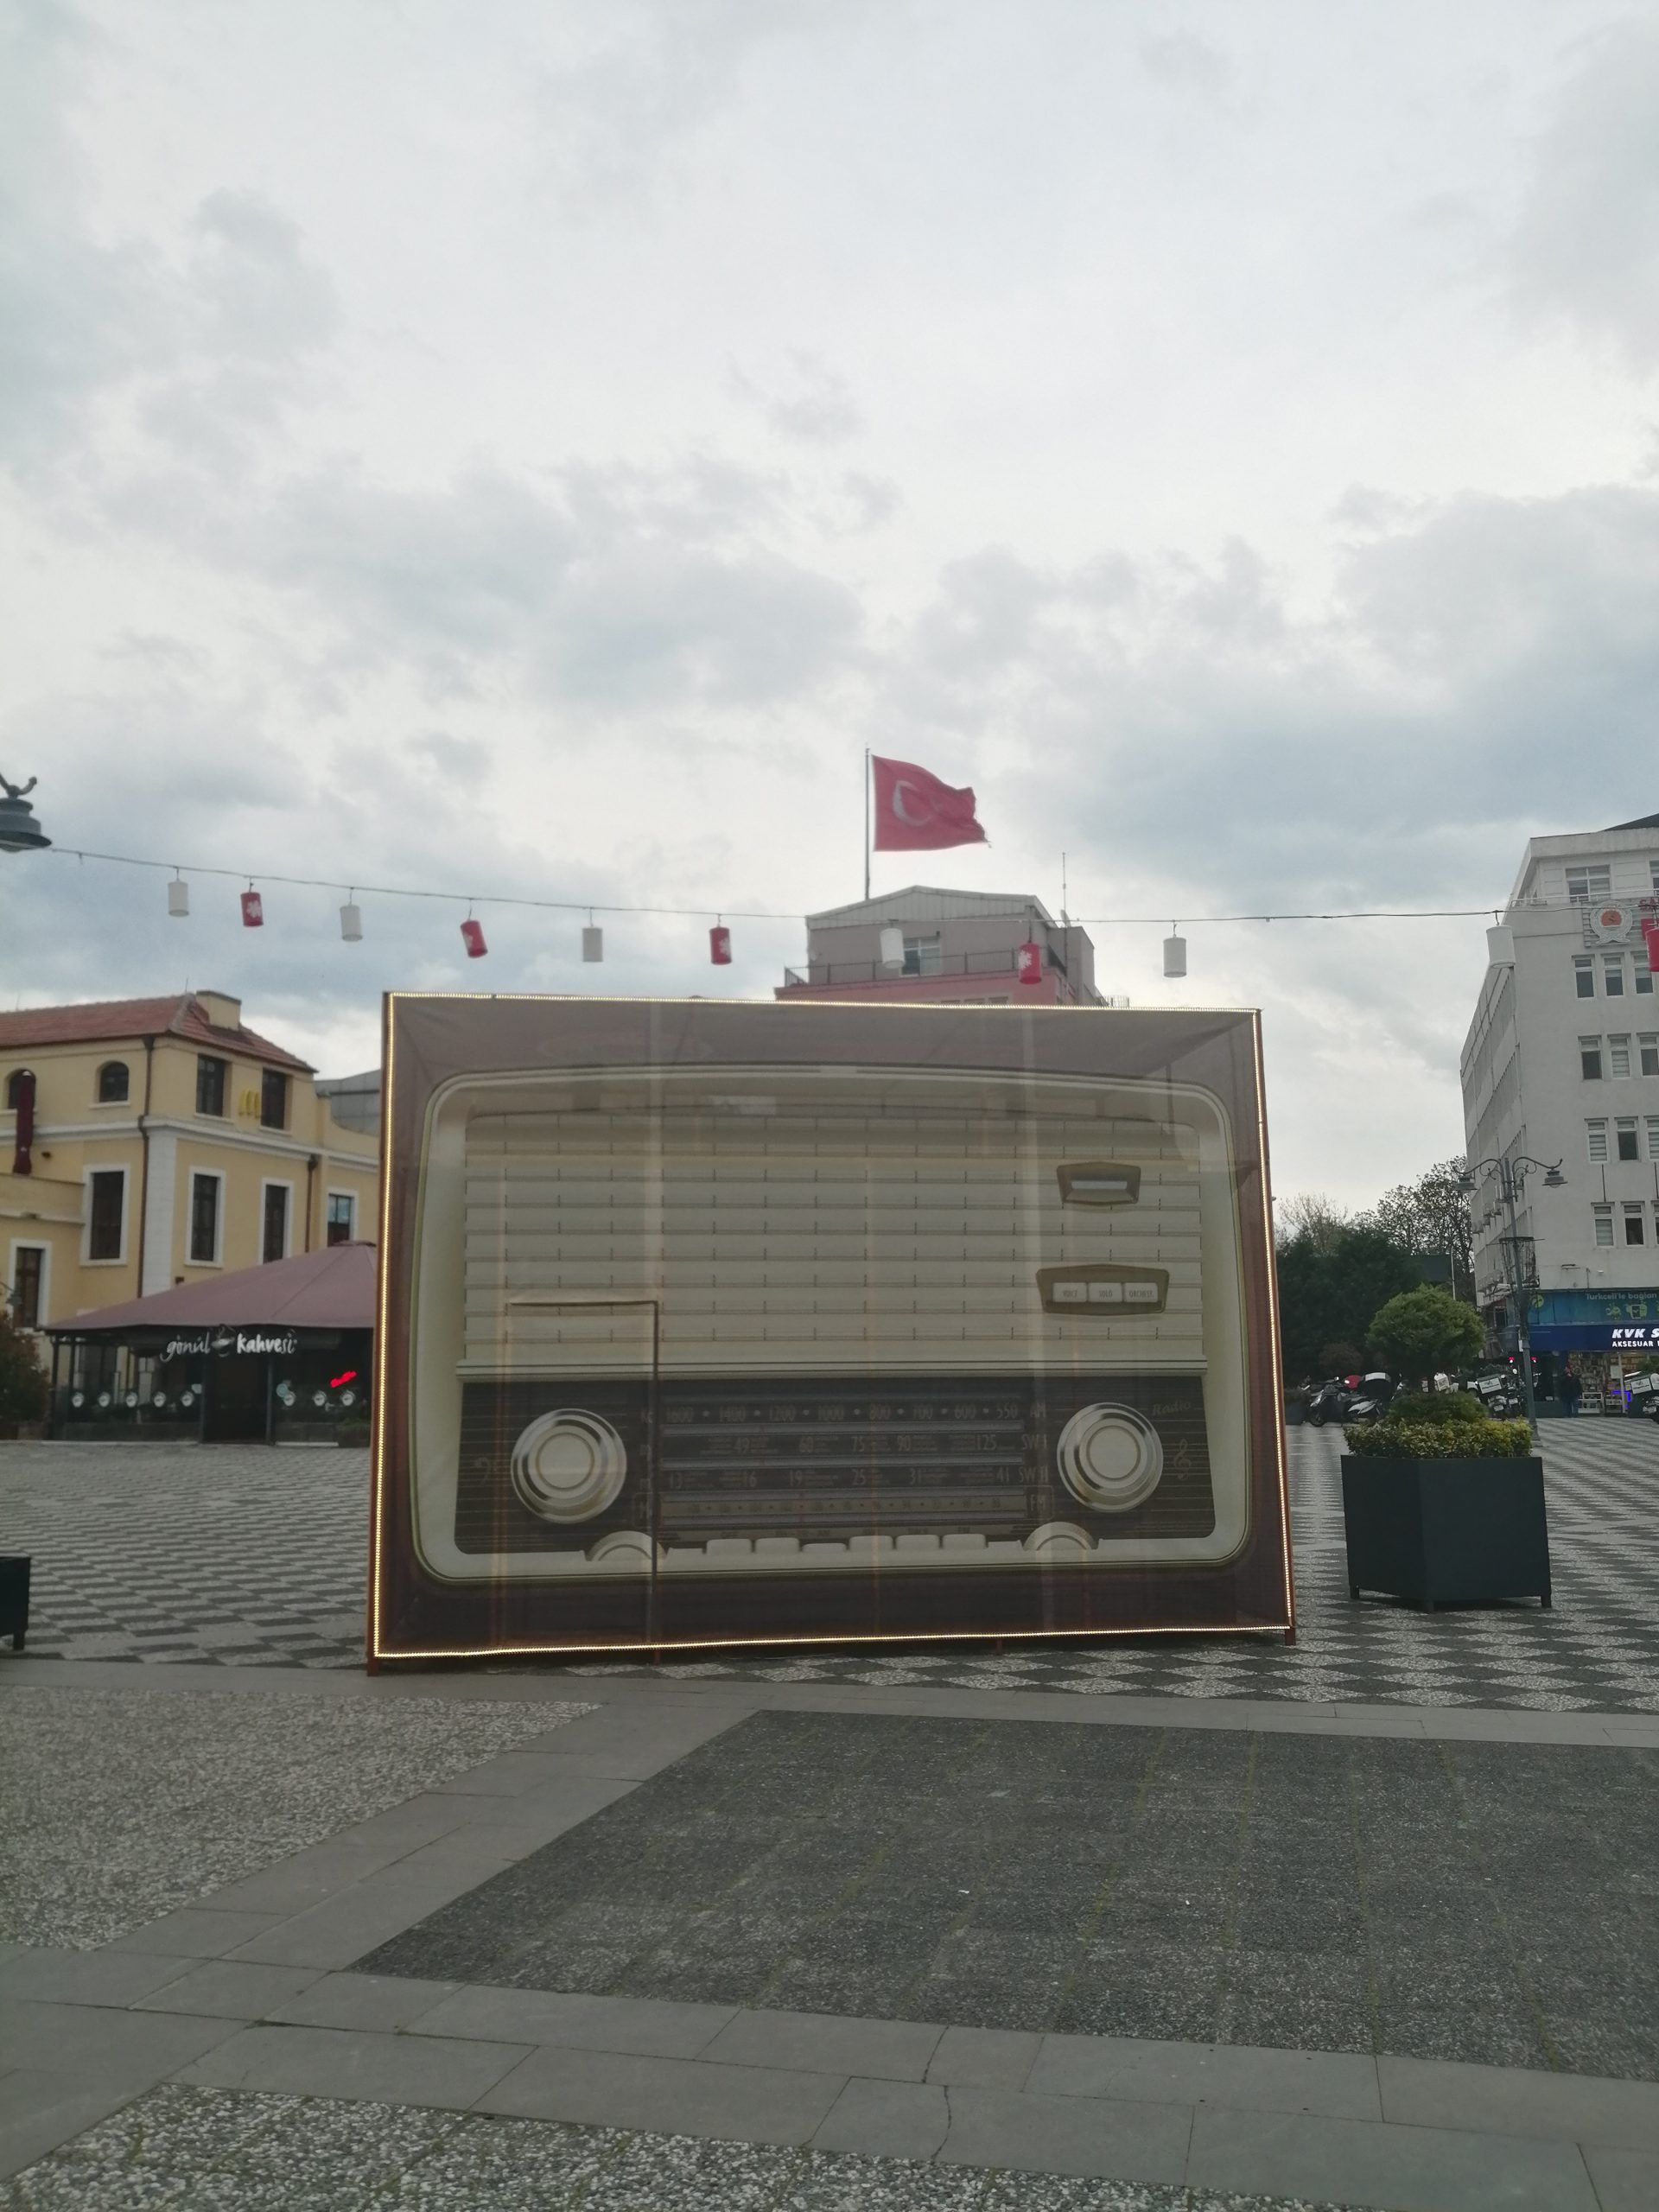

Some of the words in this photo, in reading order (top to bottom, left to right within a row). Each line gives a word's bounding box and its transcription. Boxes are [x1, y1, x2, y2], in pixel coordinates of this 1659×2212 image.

[236, 1331, 296, 1355] kahvesi
[1611, 1328, 1646, 1339] KVK
[768, 1405, 796, 1422] 1200
[817, 1403, 845, 1421] 1000
[869, 1403, 892, 1421] 800
[954, 1402, 976, 1420] 600
[996, 1402, 1019, 1420] 550
[1029, 1402, 1047, 1418] AM
[1152, 1397, 1192, 1416] Radio
[734, 1436, 750, 1453] 49
[798, 1436, 814, 1453] 60
[850, 1435, 866, 1452] 75
[897, 1434, 912, 1452] 90
[976, 1433, 997, 1451] 125
[669, 1471, 683, 1490] 13
[742, 1471, 758, 1488] 16
[789, 1470, 803, 1487] 19
[852, 1468, 866, 1485] 25
[910, 1467, 922, 1485] 31
[995, 1466, 1010, 1484] 41
[1029, 1493, 1046, 1512] FM
